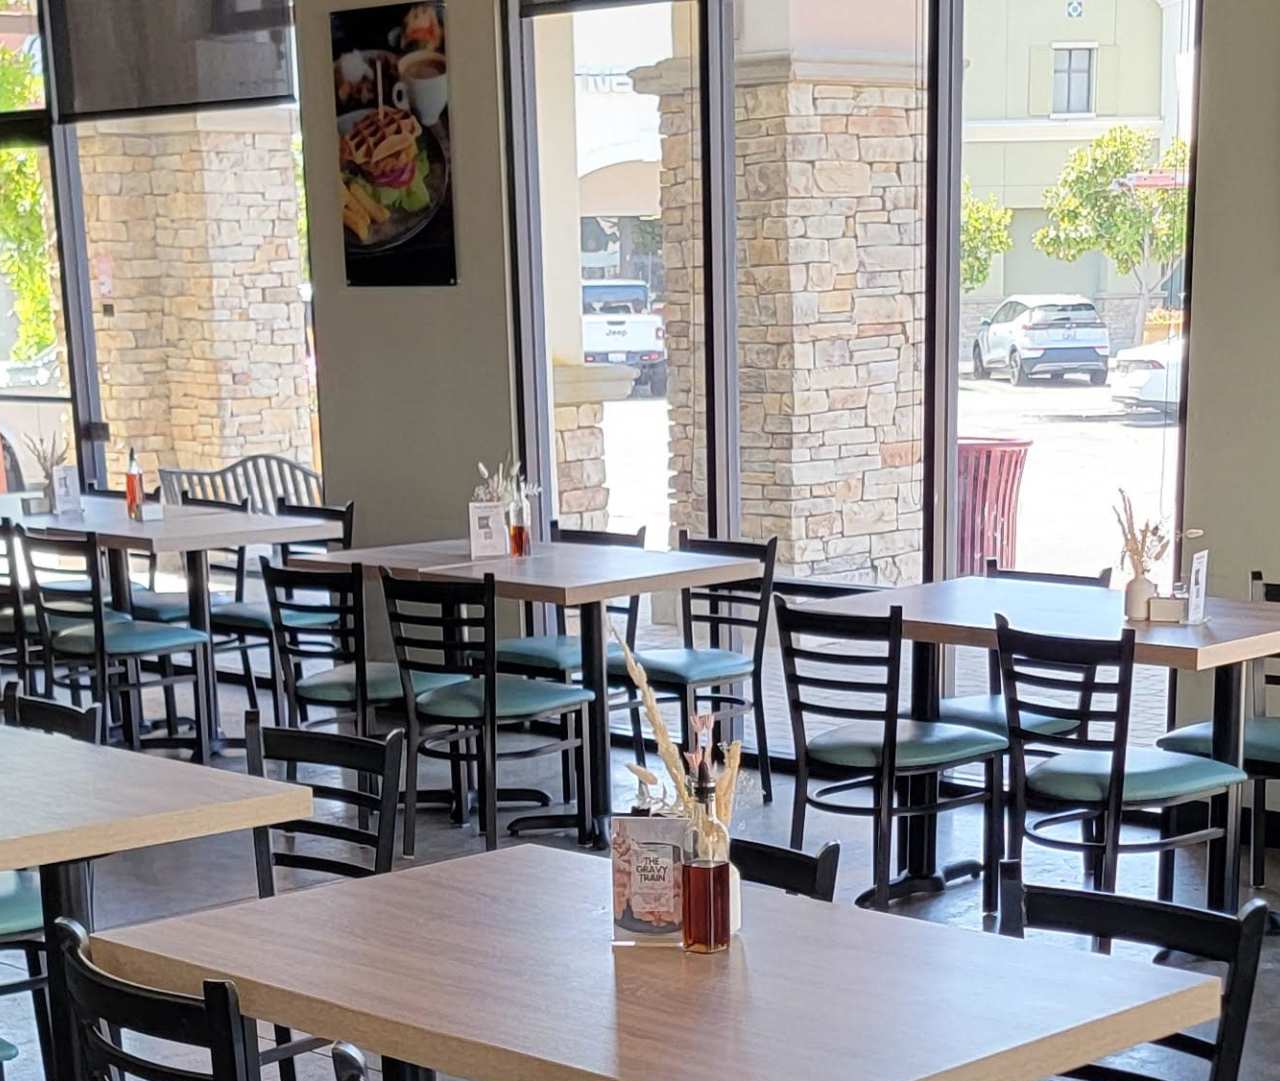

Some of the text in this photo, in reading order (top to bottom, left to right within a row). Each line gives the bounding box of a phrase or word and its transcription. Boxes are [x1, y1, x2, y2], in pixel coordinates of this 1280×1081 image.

[643, 856, 659, 866] THE
[636, 865, 668, 874] GRAVY
[639, 874, 666, 882] TRAIN
